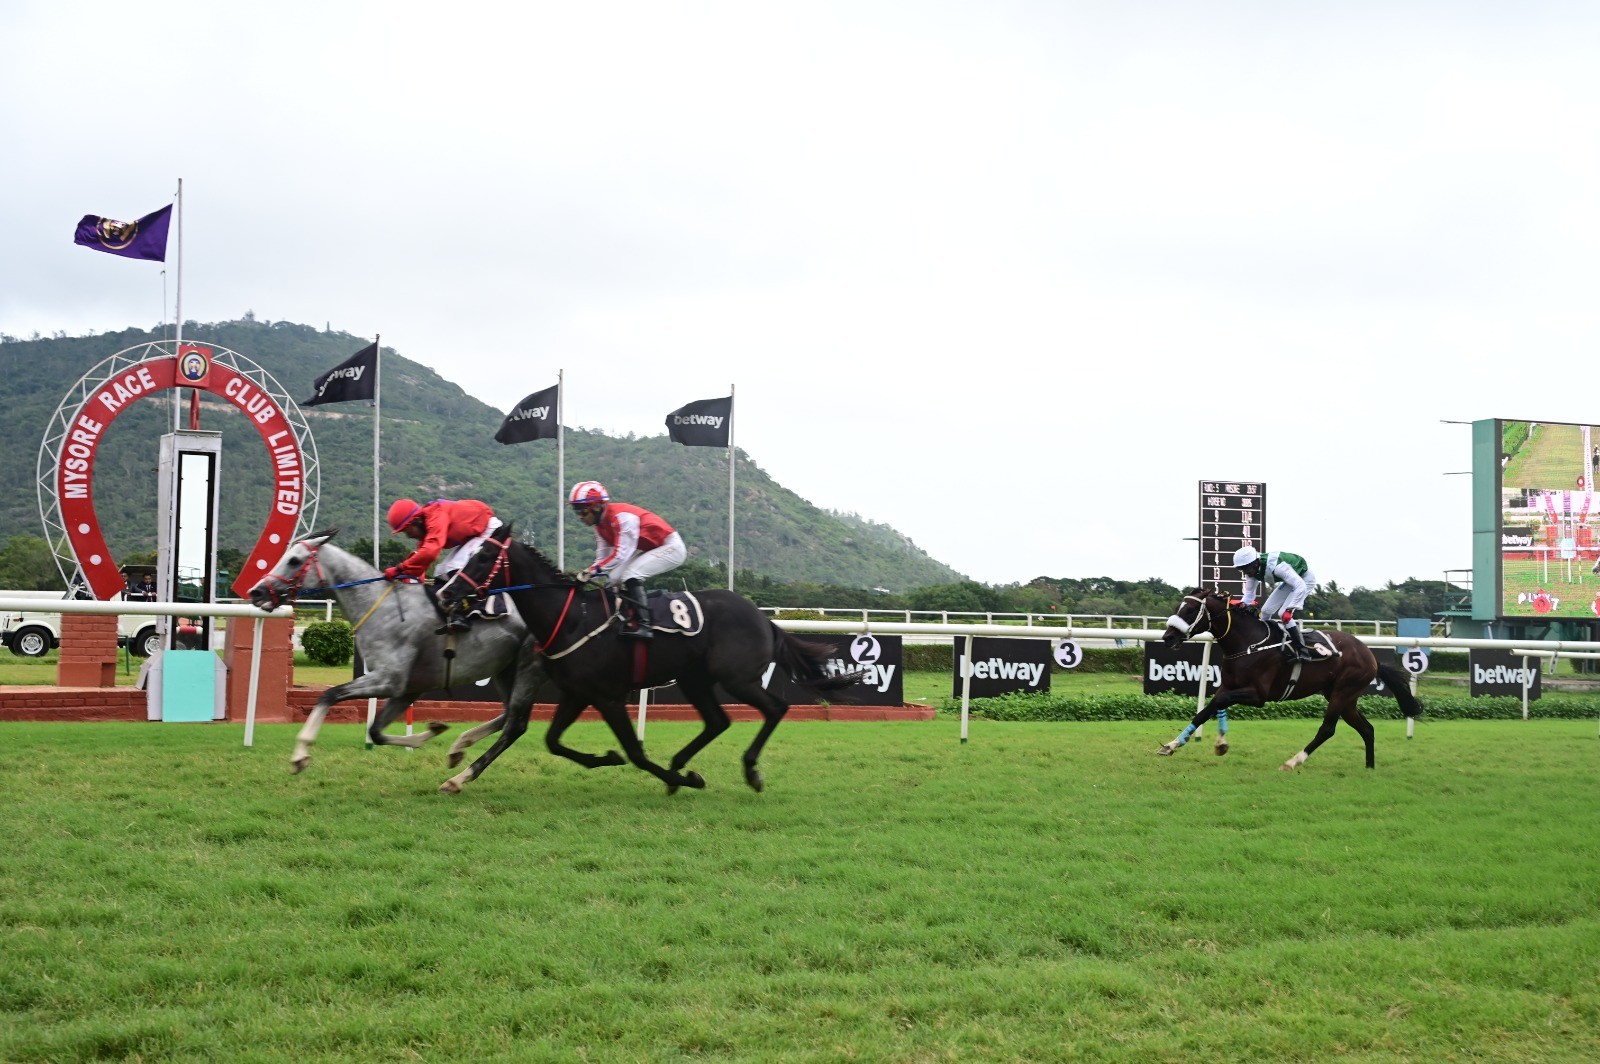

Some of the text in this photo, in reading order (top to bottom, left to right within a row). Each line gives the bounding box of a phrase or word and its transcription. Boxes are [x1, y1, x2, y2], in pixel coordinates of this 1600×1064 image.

[64, 367, 300, 515] MYSORE RACE CLUB LIMITED
[669, 599, 692, 629] 8
[857, 637, 875, 661] 2
[1060, 642, 1077, 666] 3
[1409, 652, 1423, 672] 5
[1474, 663, 1537, 689] betway
